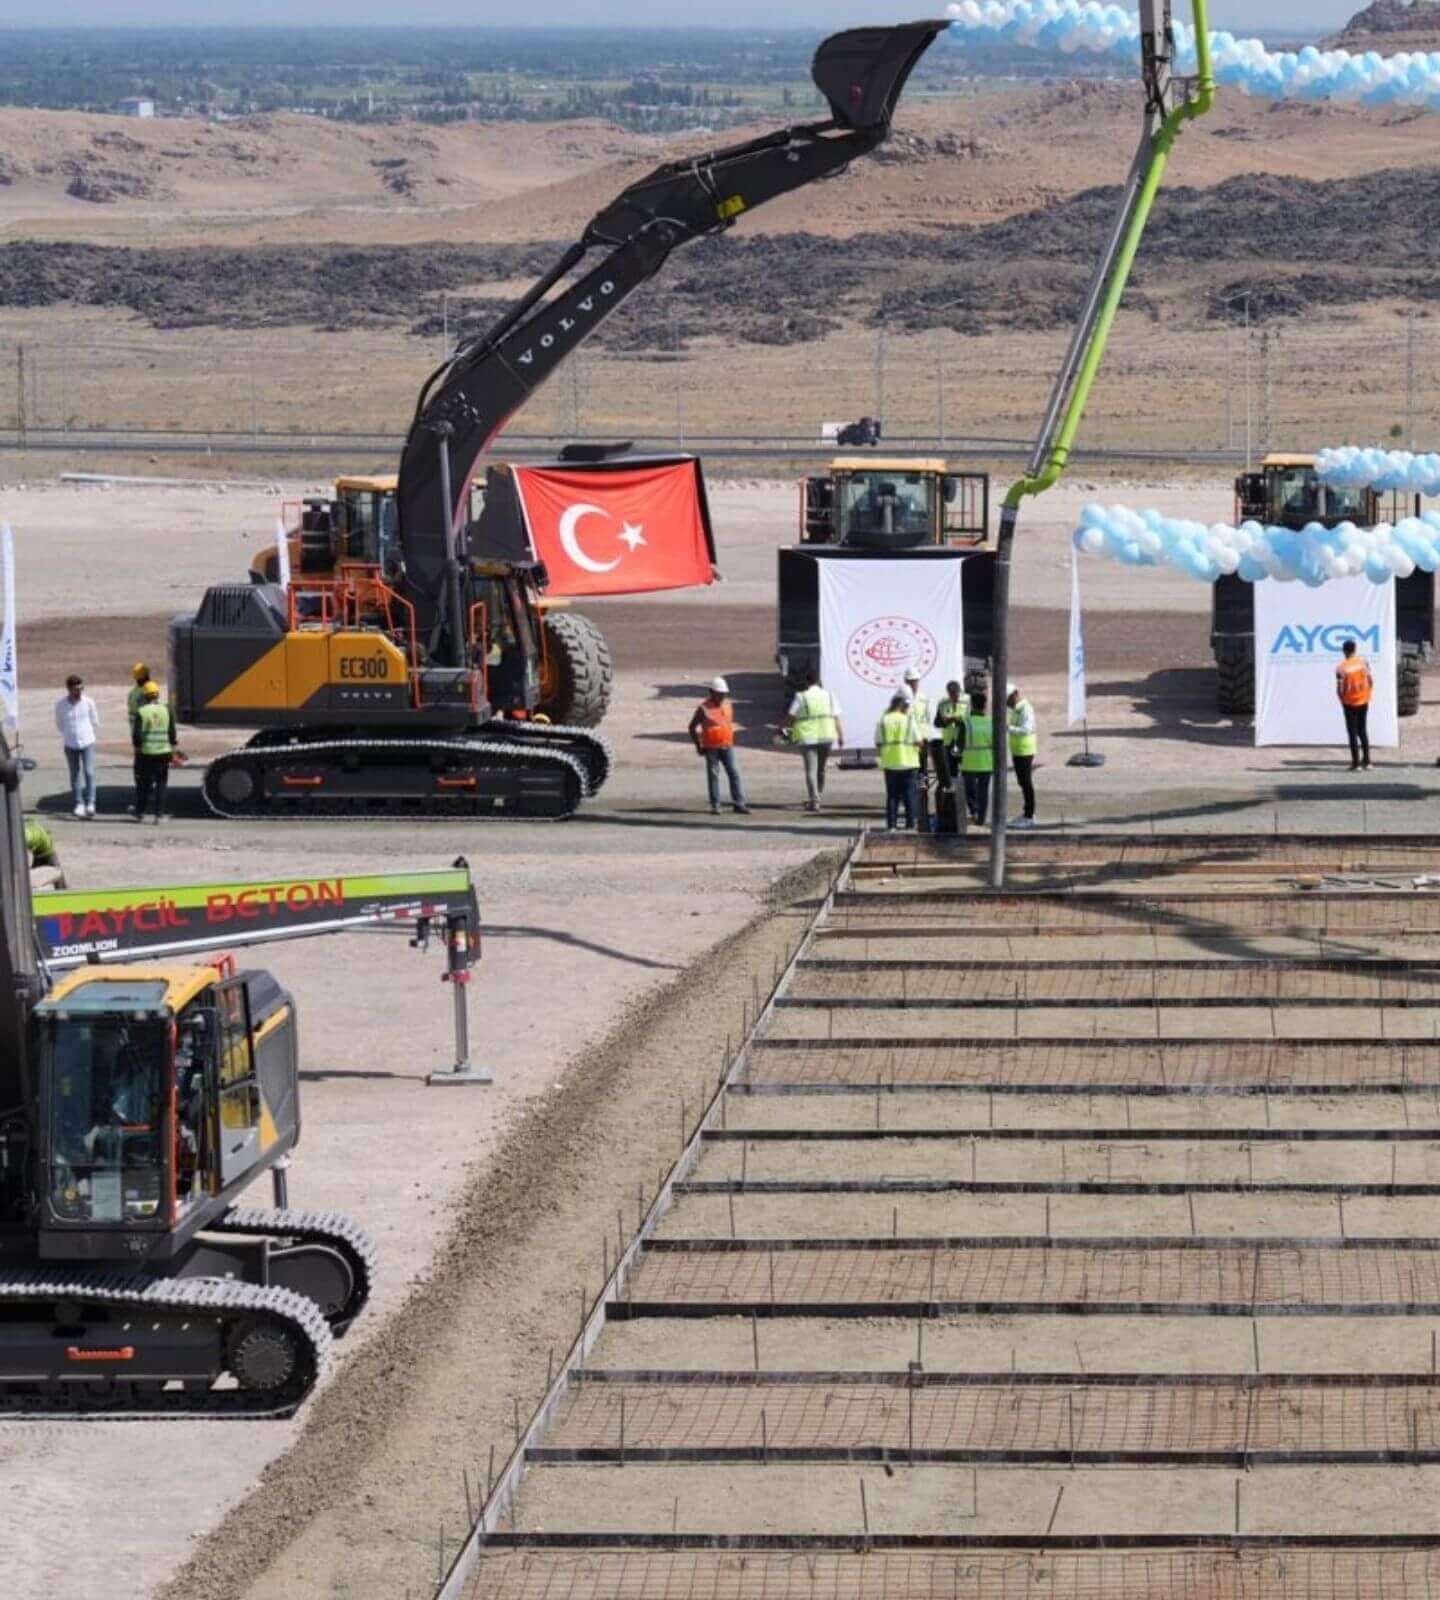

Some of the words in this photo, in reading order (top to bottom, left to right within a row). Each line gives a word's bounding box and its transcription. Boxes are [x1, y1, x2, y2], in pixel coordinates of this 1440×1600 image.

[517, 281, 615, 364] VOLVO
[1271, 623, 1380, 653] AYGM
[341, 656, 388, 679] EC300
[206, 879, 345, 923] BETON
[52, 938, 118, 957] ZOOMLION
